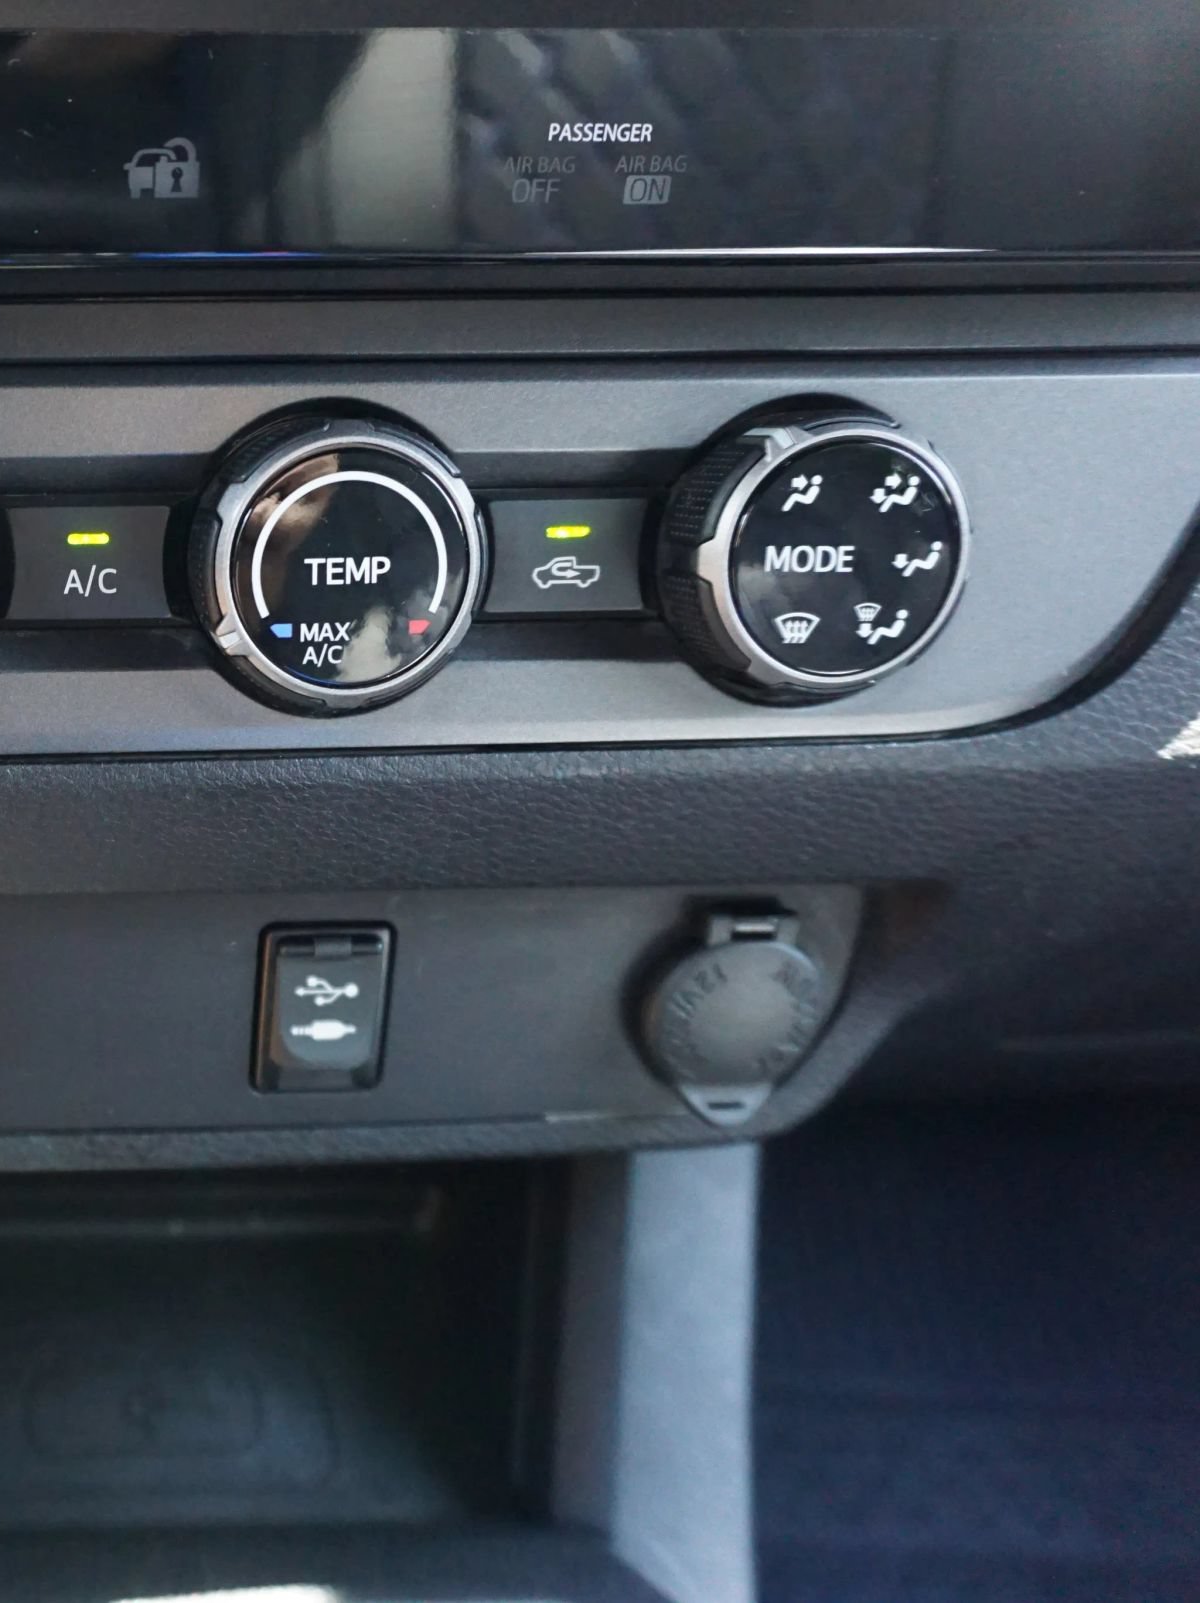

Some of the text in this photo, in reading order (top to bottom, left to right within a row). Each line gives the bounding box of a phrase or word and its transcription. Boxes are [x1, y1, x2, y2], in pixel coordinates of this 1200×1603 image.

[548, 123, 653, 143] PASSENGER
[503, 156, 576, 174] AIR BAG
[615, 155, 688, 173] AIR BAG
[511, 179, 560, 203] OFF
[629, 178, 667, 203] ON
[764, 545, 855, 572] MODE
[63, 565, 118, 597] A/C
[304, 556, 391, 586] TEMP
[300, 622, 350, 642] MAX
[302, 643, 343, 666] A/C
